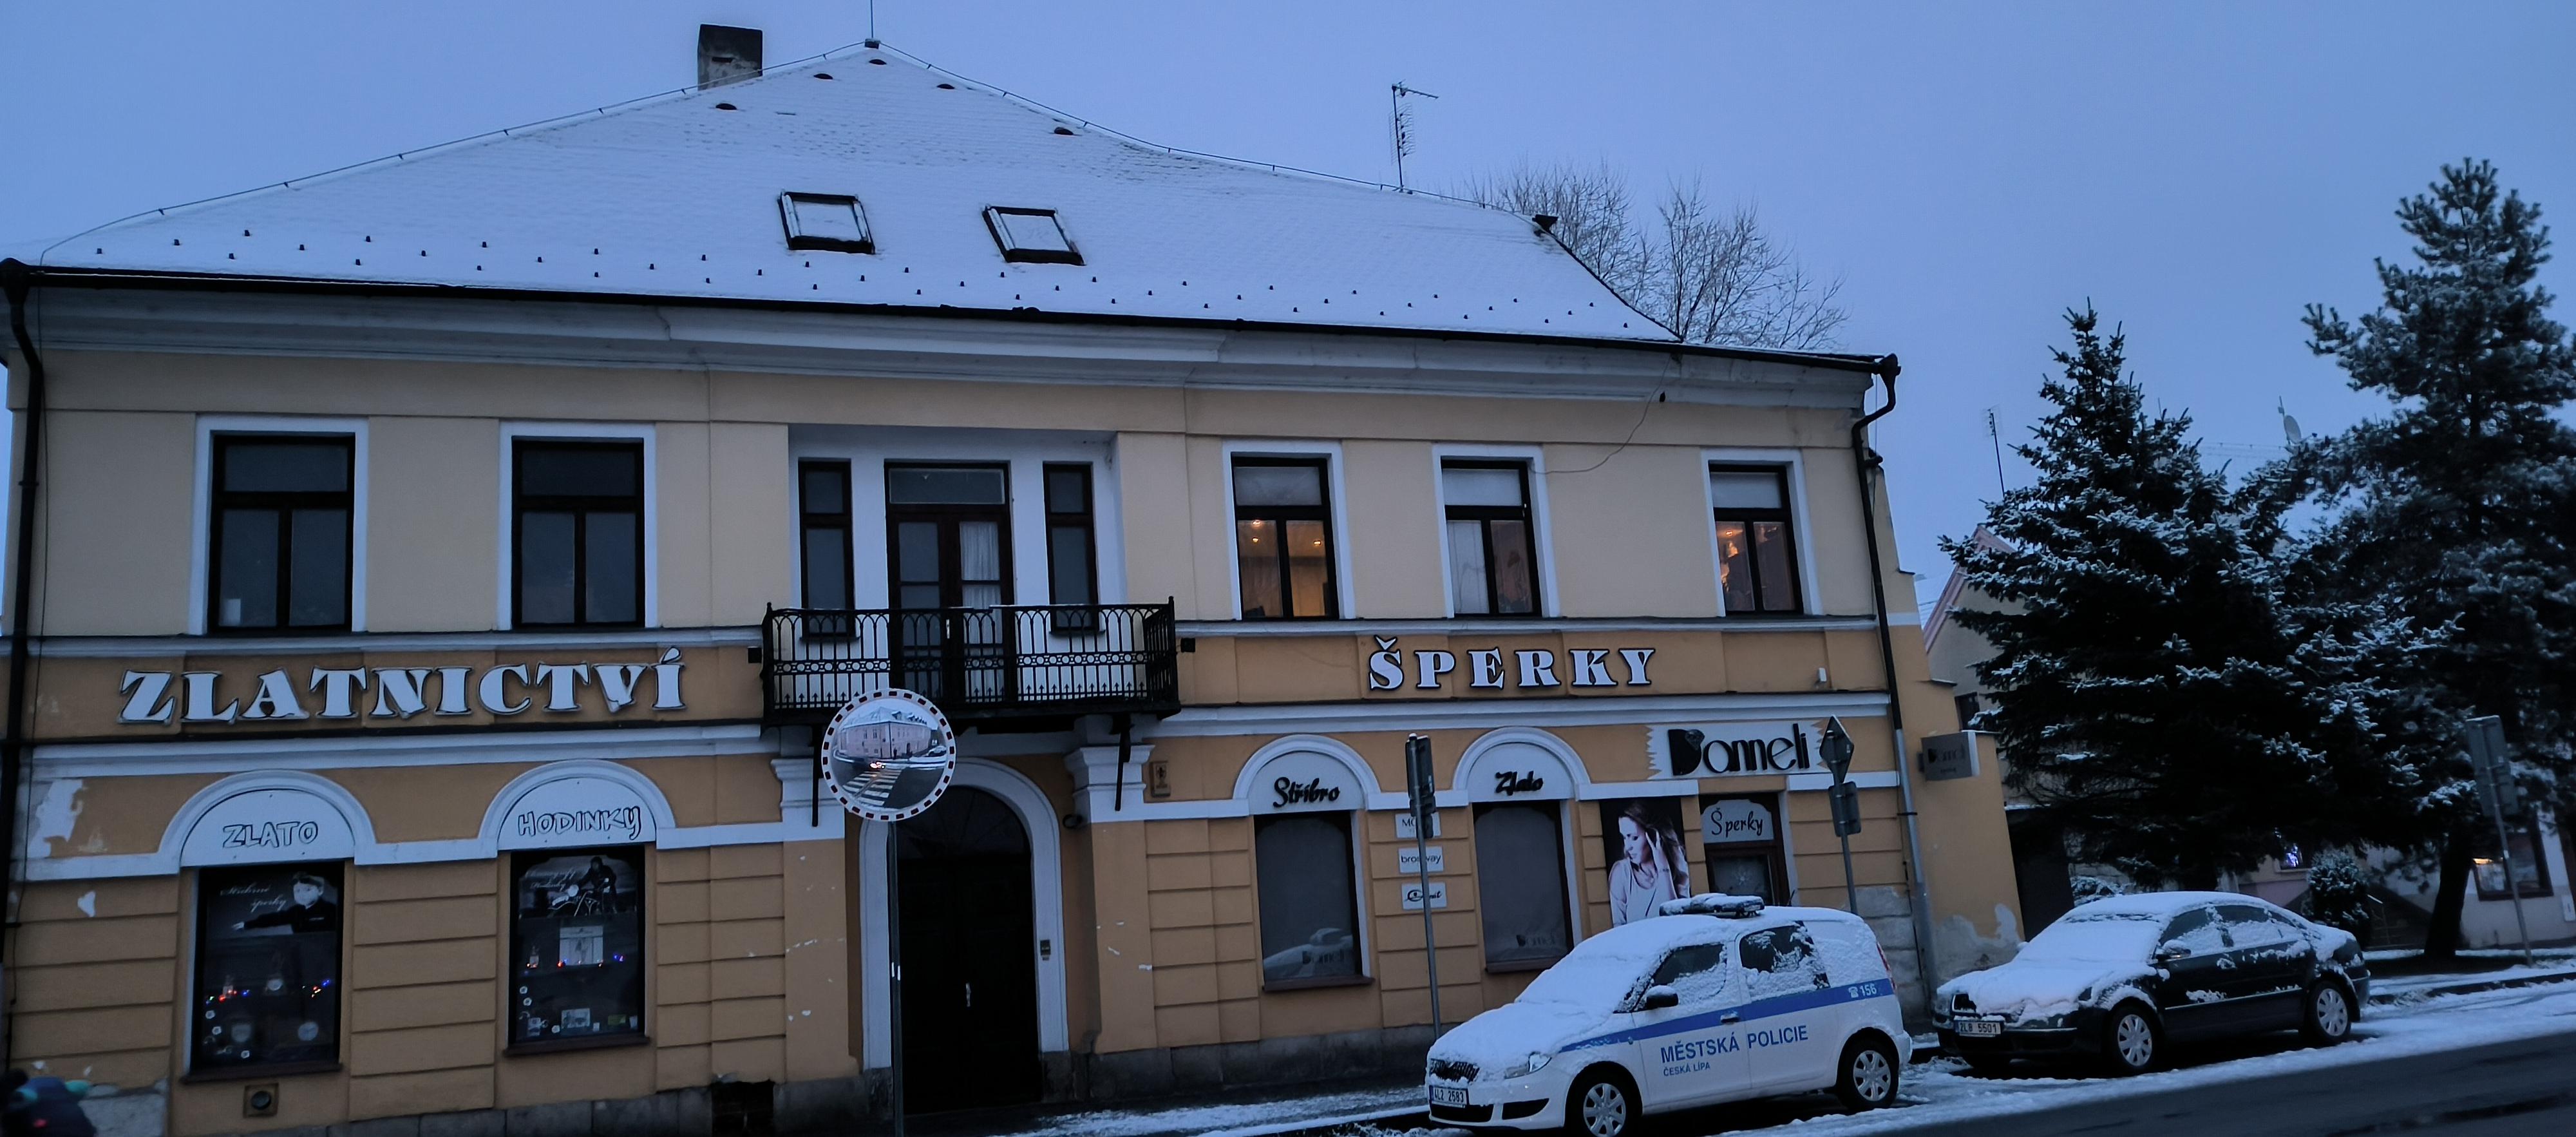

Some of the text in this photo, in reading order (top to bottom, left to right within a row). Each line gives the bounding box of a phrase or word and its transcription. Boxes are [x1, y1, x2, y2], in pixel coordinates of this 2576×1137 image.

[1368, 635, 1656, 690] ŠPERKY
[118, 647, 685, 724] ZLATNICTVÍ
[1273, 777, 1340, 808] Stříbro
[1495, 770, 1544, 796] Zlato
[222, 821, 318, 848] ZLATO
[518, 806, 641, 840] HODINKY
[1710, 807, 1763, 837] Šperky
[1860, 983, 1877, 997] 156
[1978, 1023, 1997, 1033] 5501
[1661, 1025, 1808, 1063] MĚSTSKÁ POLICIE
[1663, 1062, 1711, 1076] ČESKÁ LÍPA
